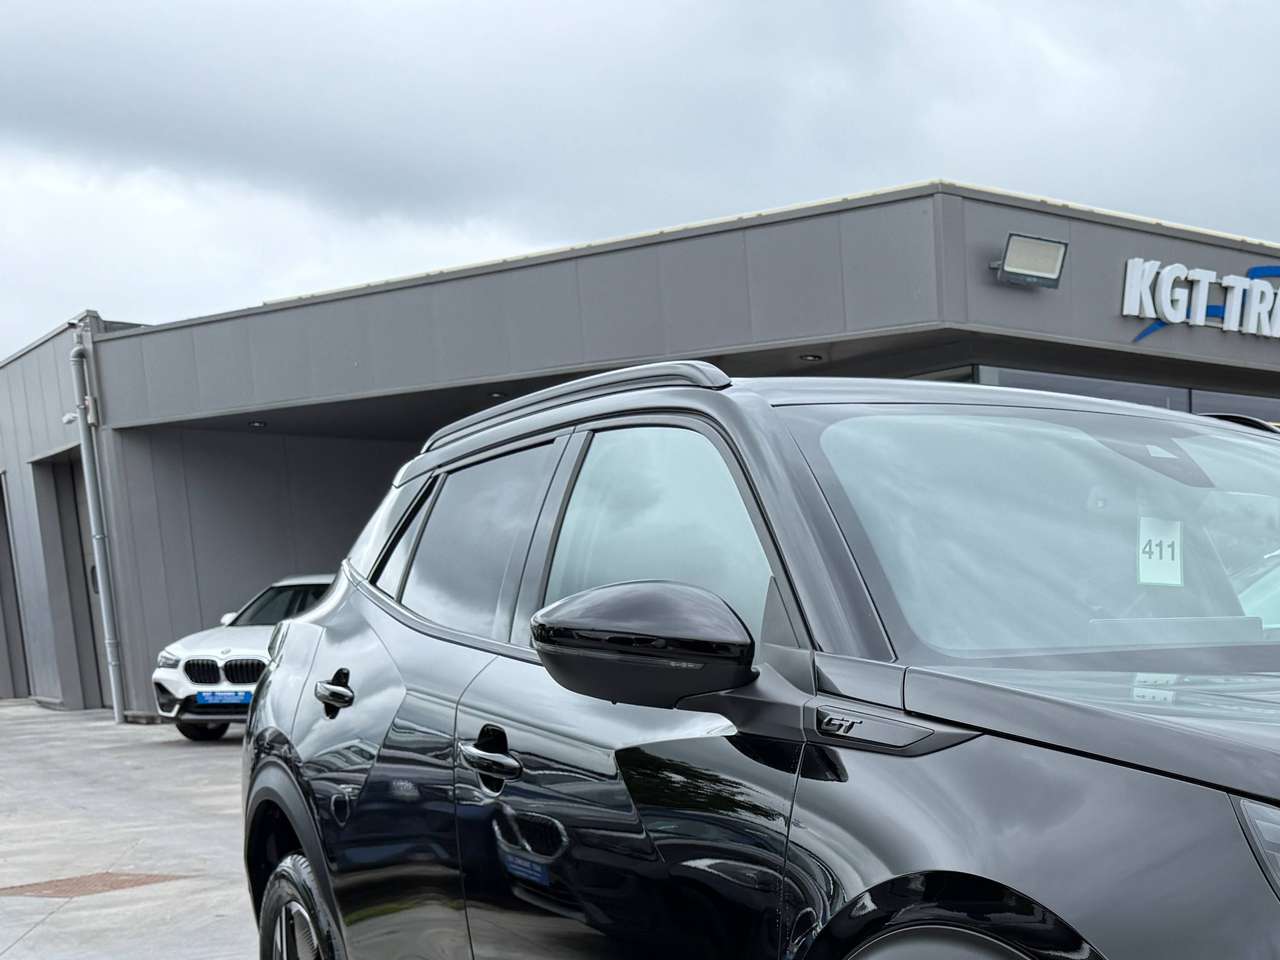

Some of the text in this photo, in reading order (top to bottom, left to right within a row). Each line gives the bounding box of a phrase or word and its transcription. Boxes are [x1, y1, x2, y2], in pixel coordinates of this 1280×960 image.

[1122, 257, 1217, 326] KGT
[1141, 539, 1176, 561] 411
[821, 716, 863, 734] GT
